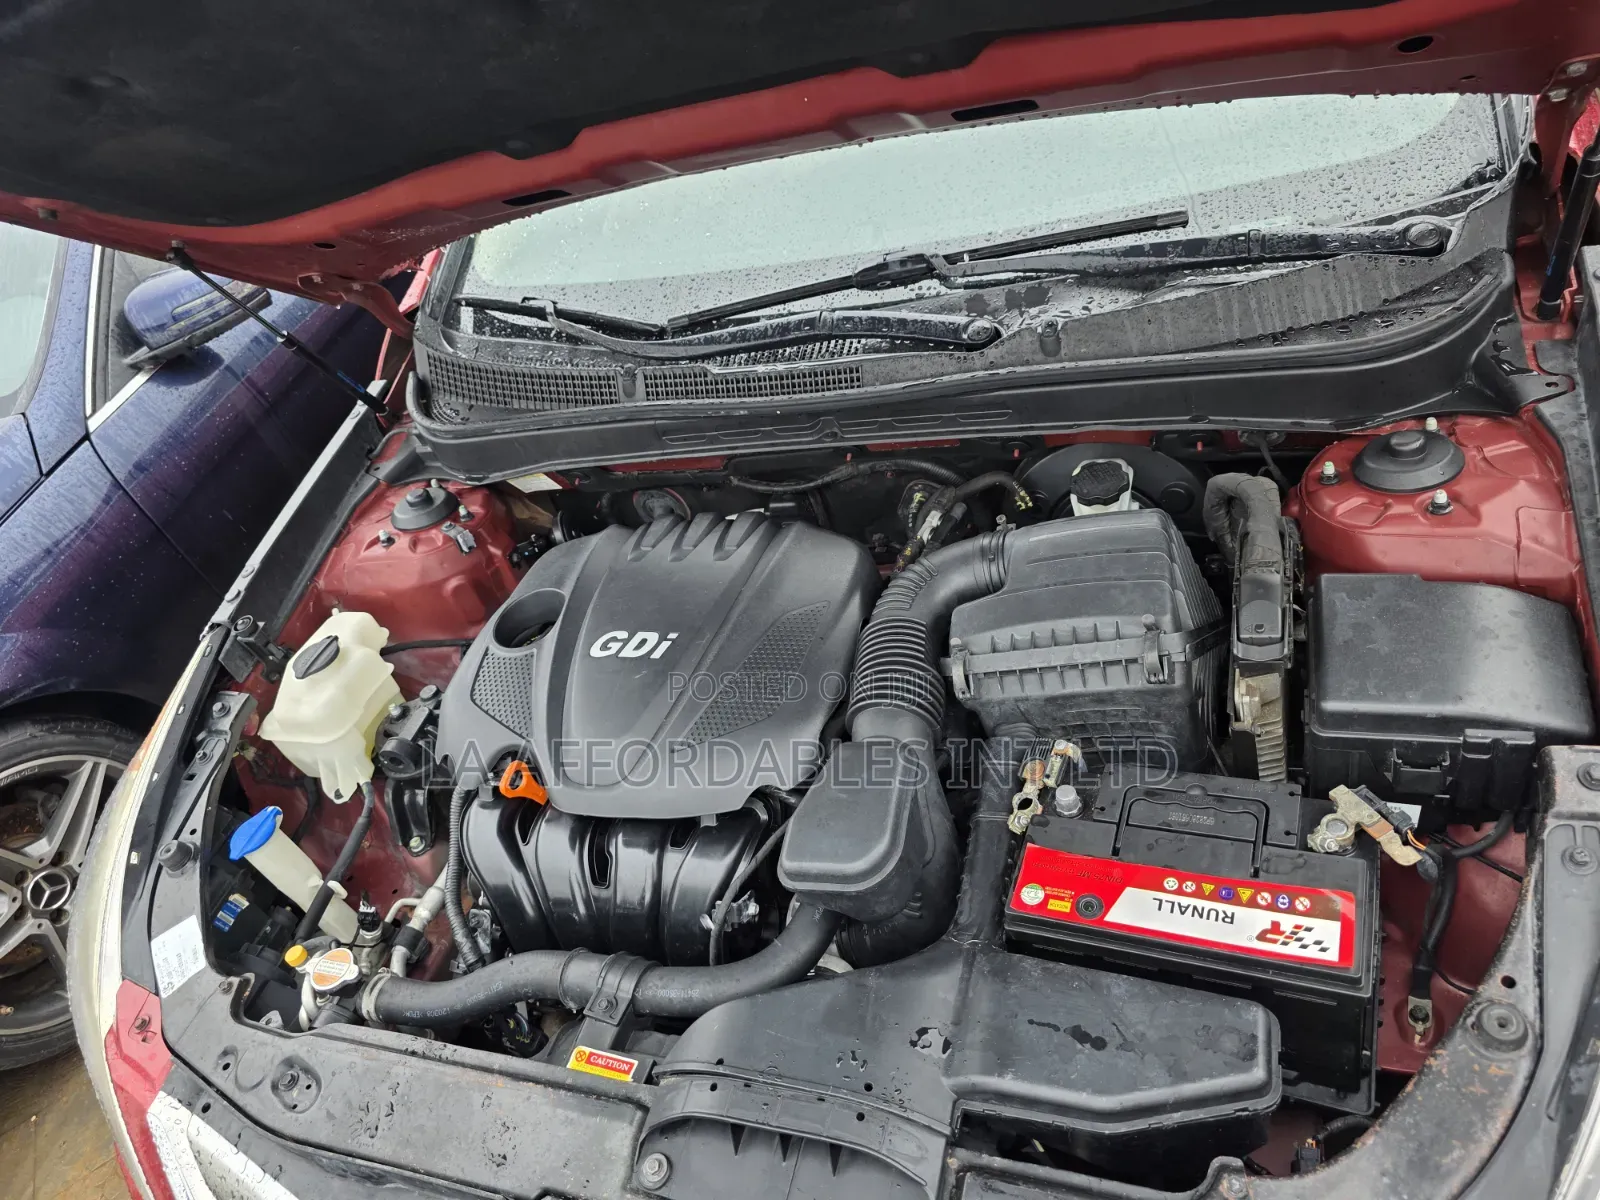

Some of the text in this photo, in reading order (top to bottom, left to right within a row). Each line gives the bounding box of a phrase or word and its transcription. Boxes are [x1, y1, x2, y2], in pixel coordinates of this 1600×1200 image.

[589, 630, 680, 659] GDi
[1152, 897, 1236, 925] RUNALL
[590, 1055, 631, 1072] CAUTION
